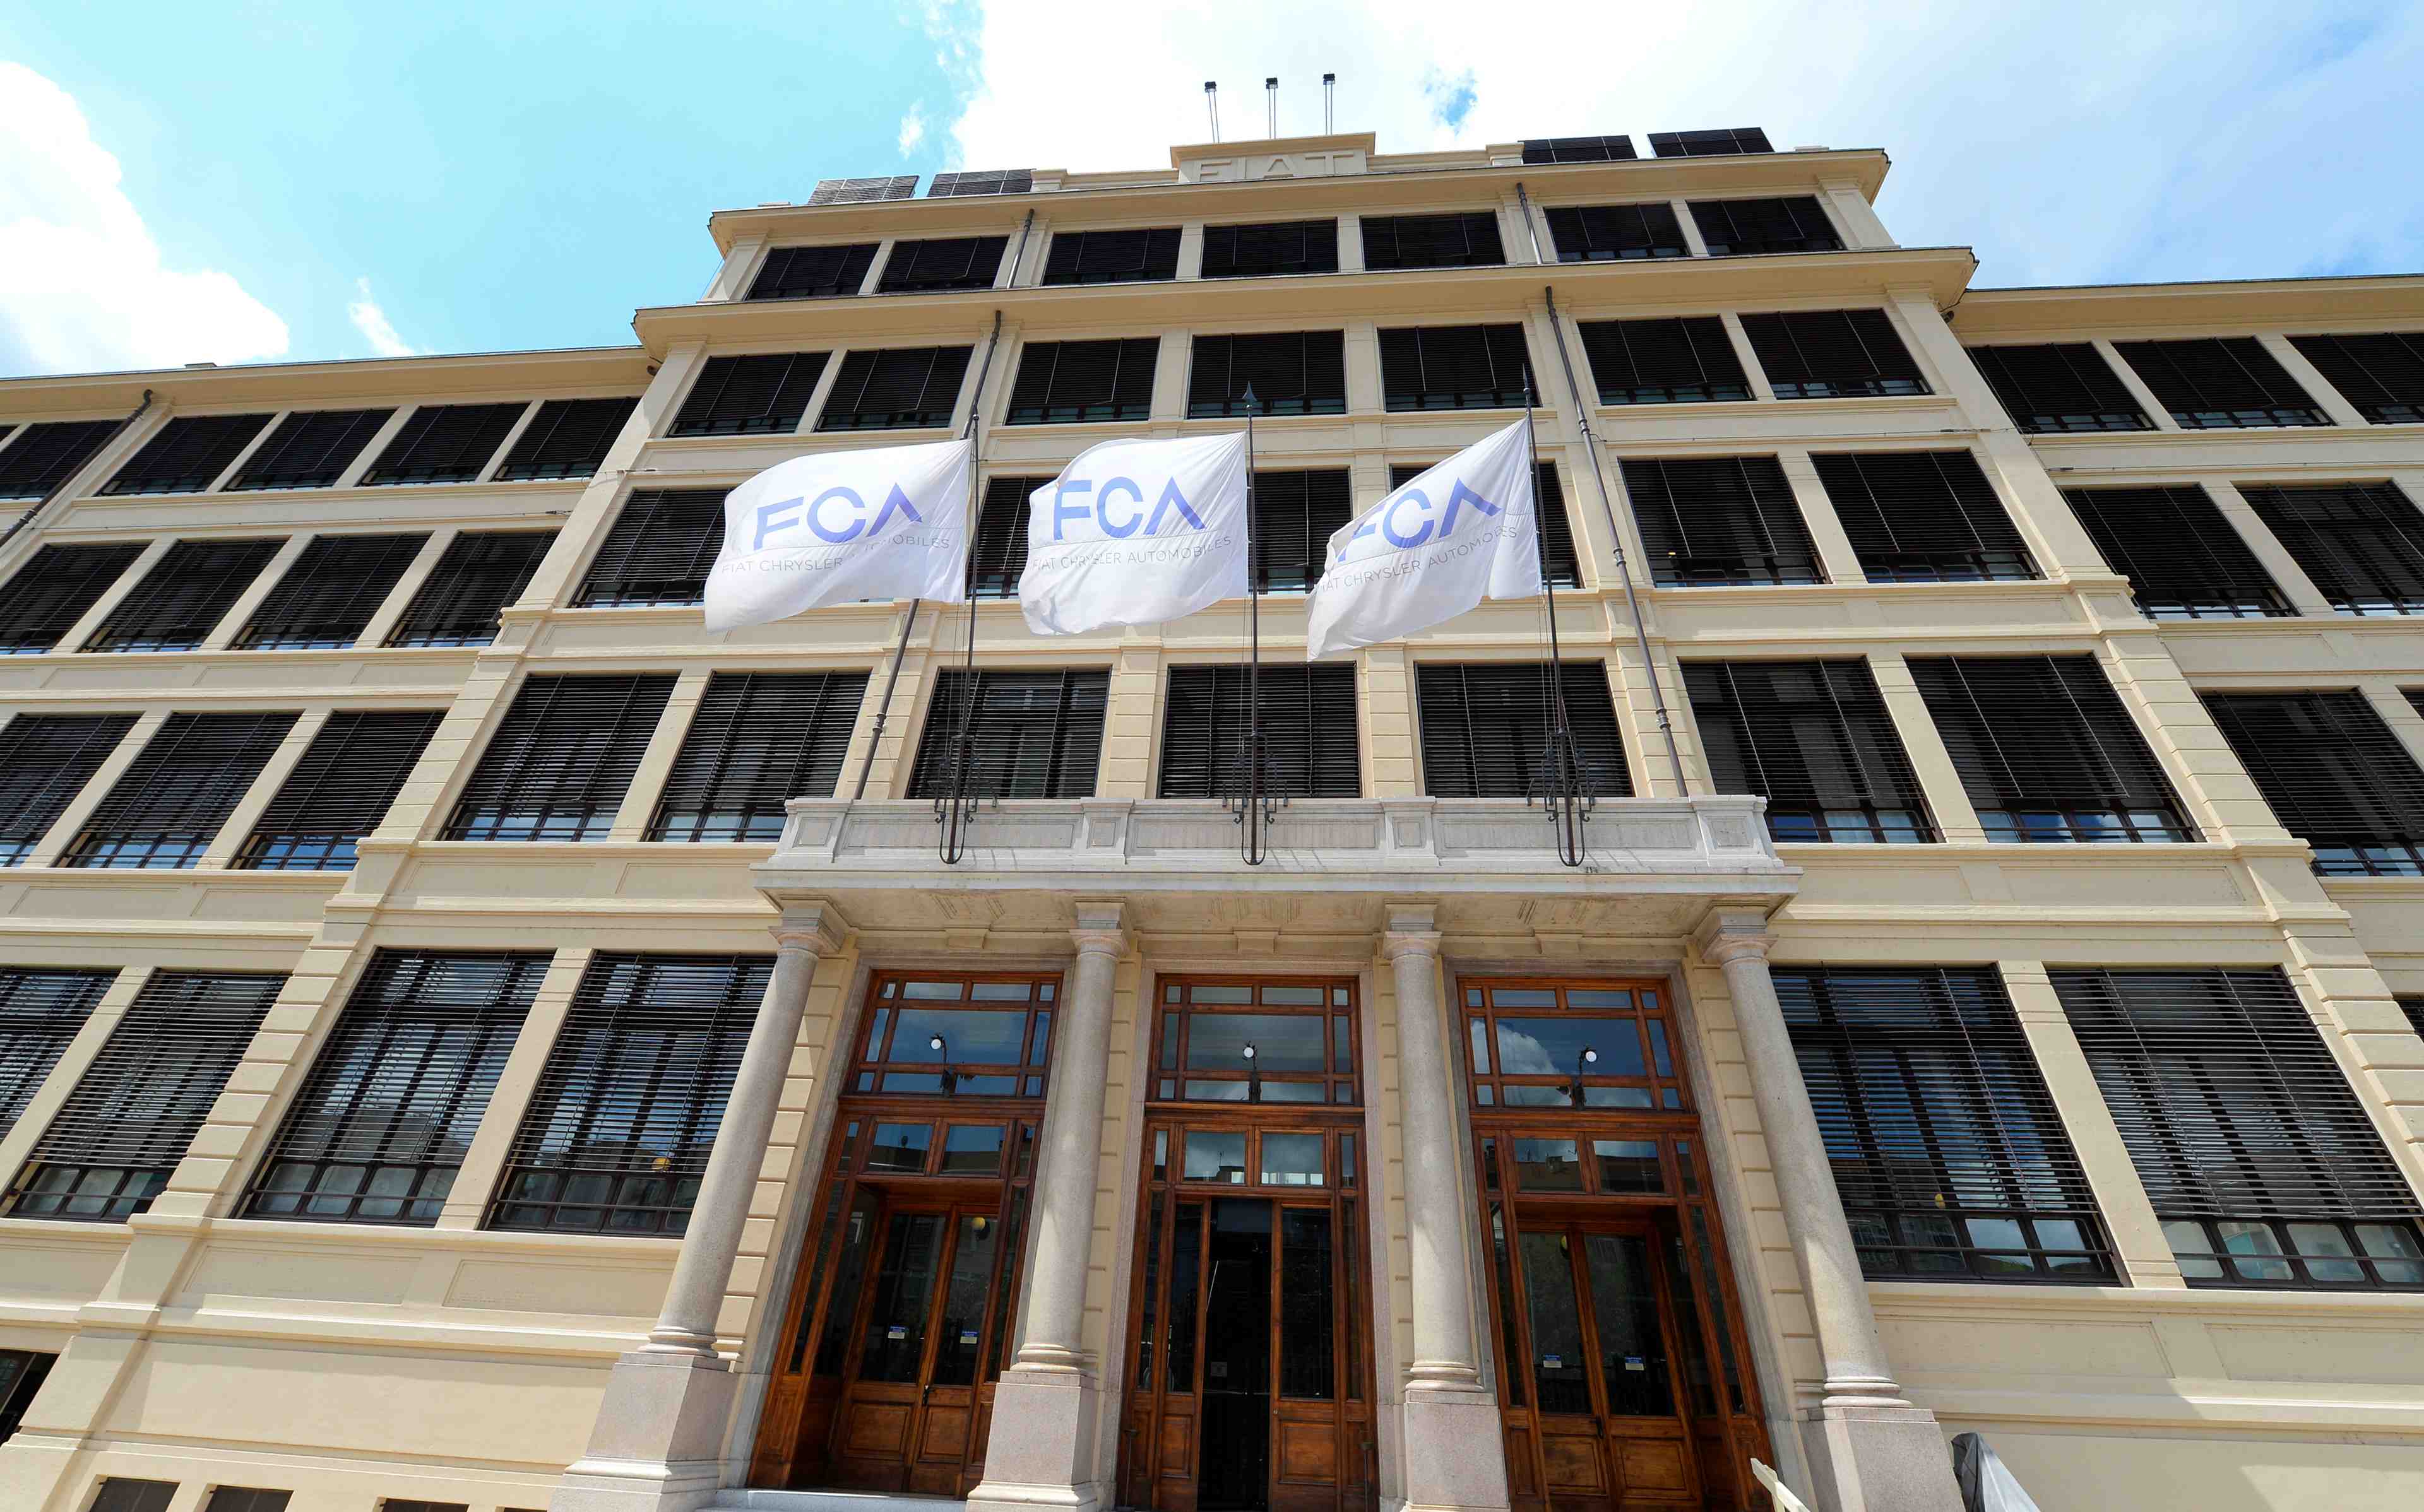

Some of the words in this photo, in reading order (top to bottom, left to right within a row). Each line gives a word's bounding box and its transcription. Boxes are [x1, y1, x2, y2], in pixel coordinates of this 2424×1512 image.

[1194, 152, 1355, 182] FIAT
[753, 482, 922, 551] FCA
[1054, 476, 1206, 541] FCA
[1127, 536, 1231, 564] AUTOMOBILES
[722, 560, 754, 575] FIAT
[759, 557, 843, 571] CHRYSLER
[1343, 560, 1422, 587] CHRYSLER
